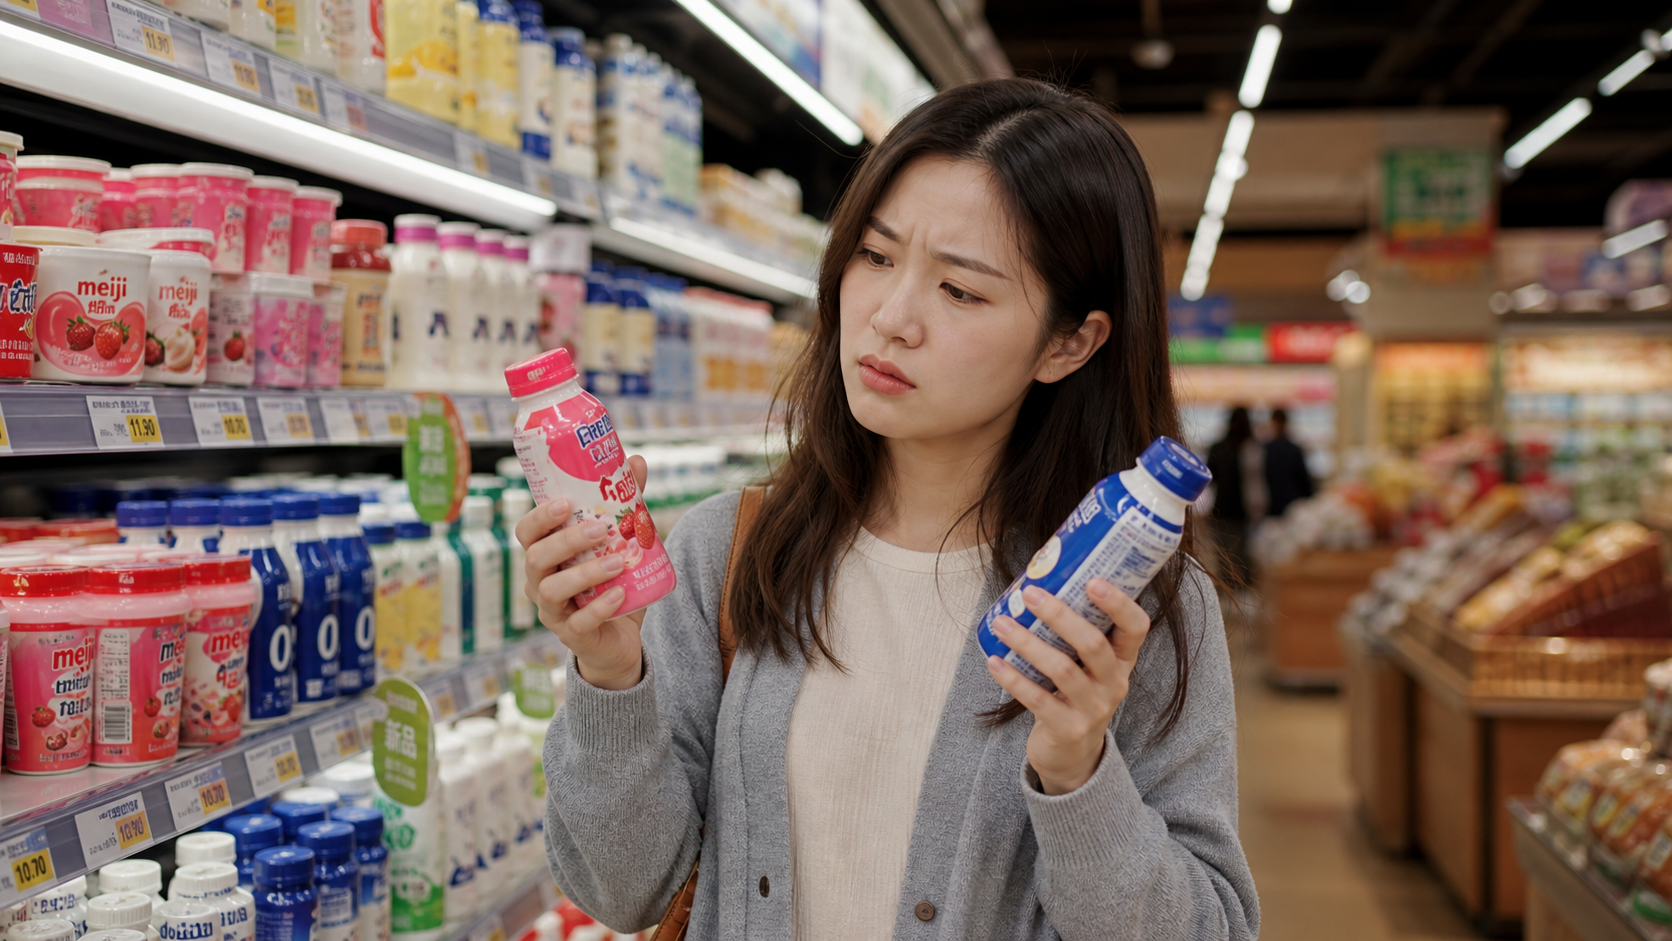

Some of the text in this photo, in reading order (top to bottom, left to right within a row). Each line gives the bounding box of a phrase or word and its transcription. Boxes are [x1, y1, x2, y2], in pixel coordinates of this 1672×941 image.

[77, 276, 127, 302] meiji
[158, 281, 198, 306] meiji
[130, 418, 155, 436] 11.90
[269, 624, 292, 673] 0
[15, 855, 47, 884] 10.70
